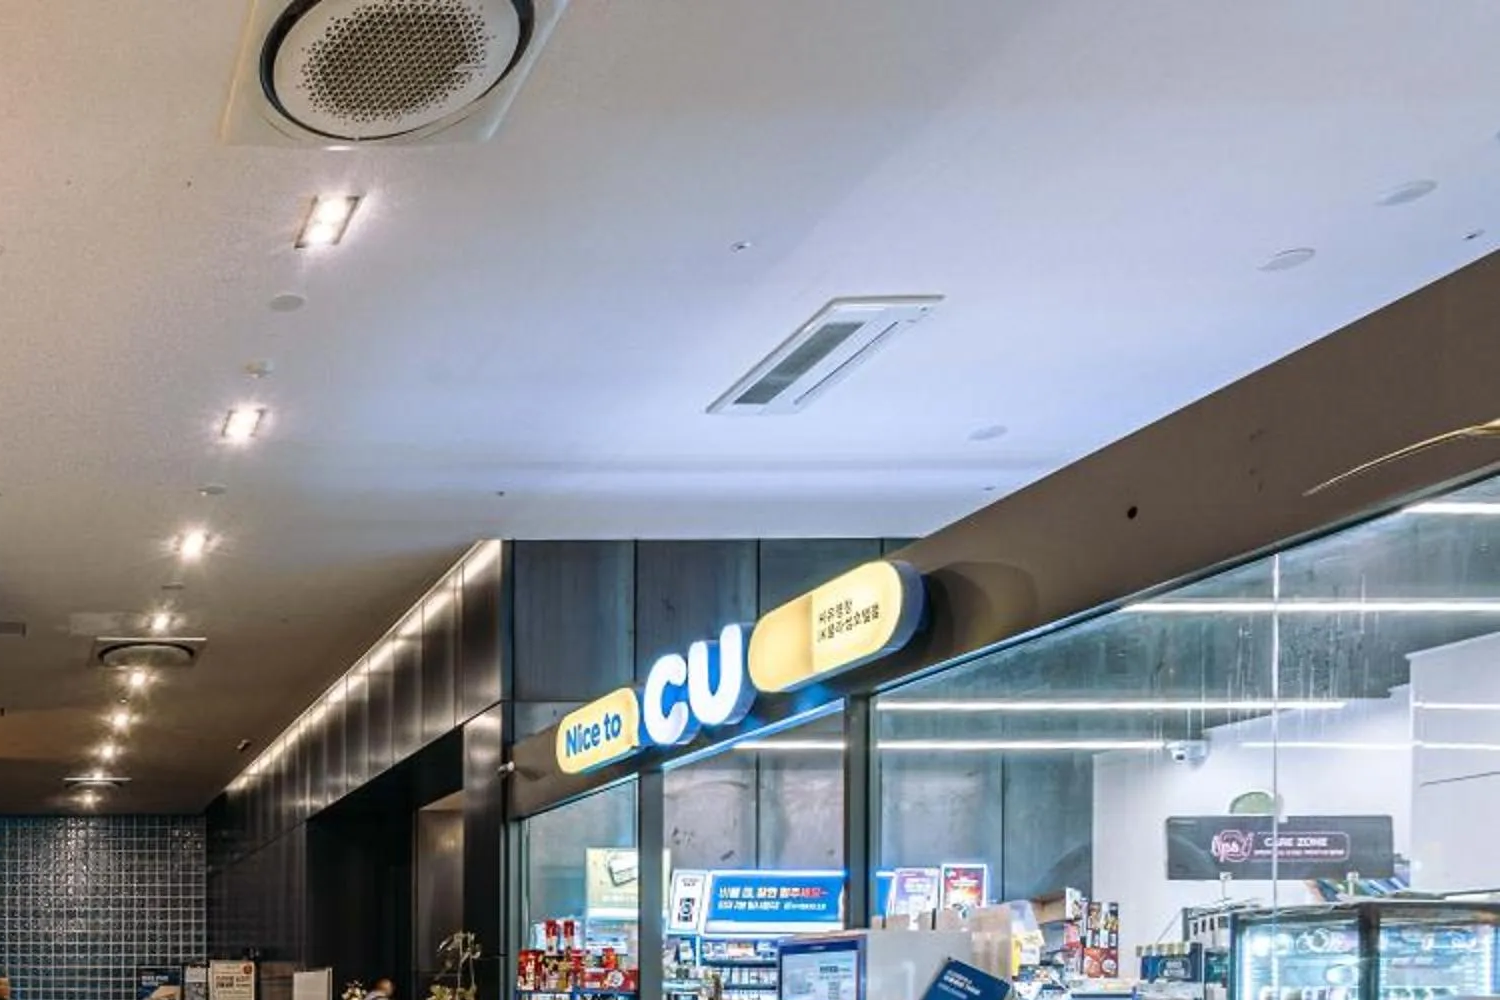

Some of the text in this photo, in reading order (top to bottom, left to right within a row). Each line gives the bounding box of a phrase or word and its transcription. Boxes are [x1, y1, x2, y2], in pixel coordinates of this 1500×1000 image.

[566, 623, 743, 757] Nice to CU
